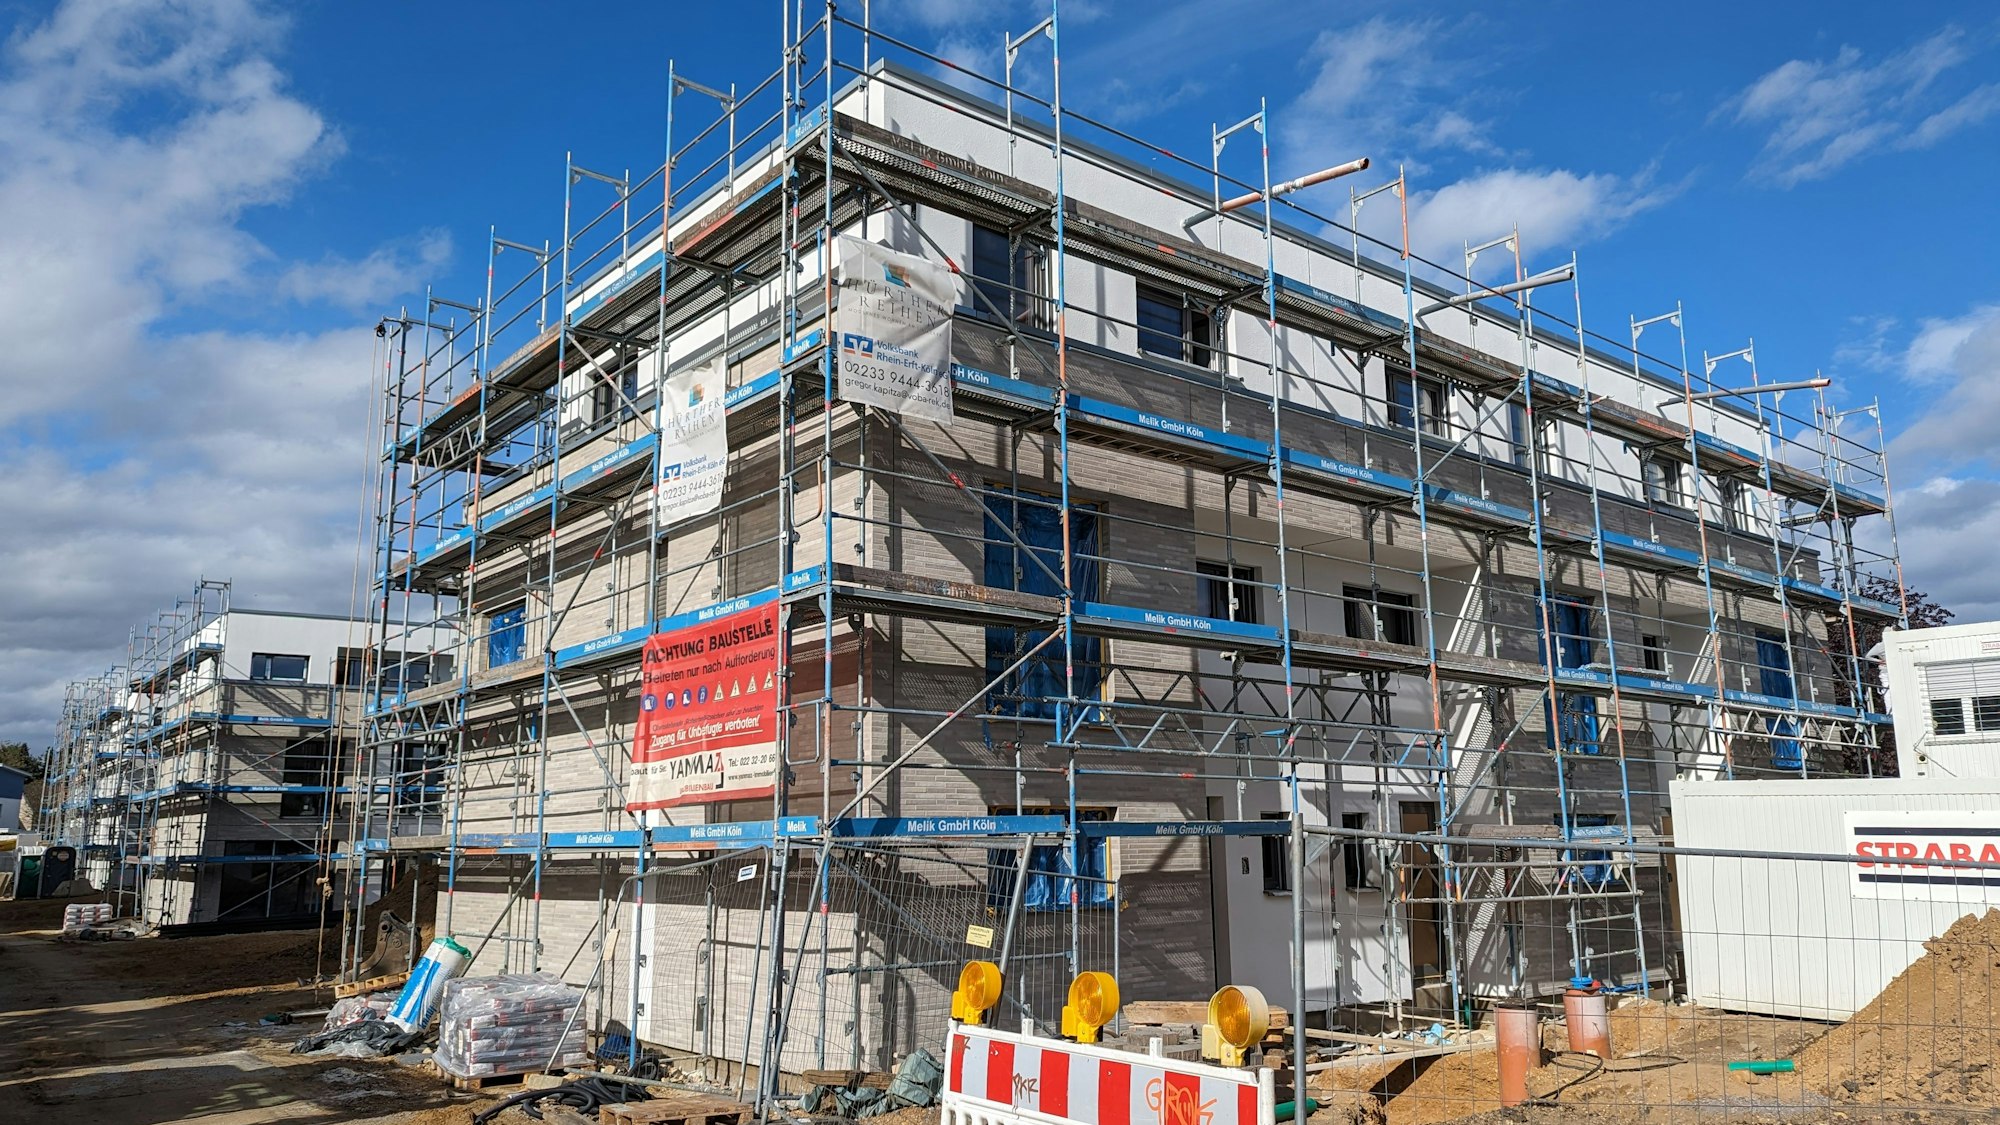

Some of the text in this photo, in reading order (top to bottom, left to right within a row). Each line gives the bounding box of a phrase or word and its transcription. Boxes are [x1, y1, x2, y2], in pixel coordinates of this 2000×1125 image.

[847, 278, 945, 317] HÜRTHER
[860, 296, 935, 327] REIHEN
[792, 340, 810, 357] Melik
[876, 340, 919, 359] Volksbank
[844, 361, 949, 397] 02233 9444-3618
[967, 369, 989, 384] Köln
[738, 386, 753, 398] Köln
[668, 397, 720, 428] HÜRTHER
[675, 412, 714, 439] REIHEN
[1138, 414, 1204, 438] Melik GmbH Köln
[683, 454, 707, 469] Volksbank
[1321, 459, 1374, 481] Melik GmbH Köln
[663, 485, 687, 500] 02233
[1454, 493, 1498, 512] Melik GmbH Köln
[792, 572, 811, 588] Melik
[699, 599, 750, 621] Melik GmbH Köln
[1144, 612, 1212, 631] Melik GmbH Köln
[645, 618, 774, 665] ACHTUNG BAUSTELLE
[643, 647, 775, 686] Betreten nur nach Aufforderung
[1558, 669, 1598, 681] Melik GmbH Köln
[651, 714, 761, 747] Zugang für Unbefugte verboten!
[739, 756, 750, 766] 022
[751, 754, 767, 764] 32-20
[690, 825, 742, 838] Melik GmbH Köln
[786, 820, 807, 833] Melik
[907, 818, 997, 833] Melik GmbH Köln
[1155, 824, 1224, 835] Melik GmbH Köln
[575, 833, 615, 844] Melik GmbH Köln
[1856, 842, 2000, 870] STRABA
